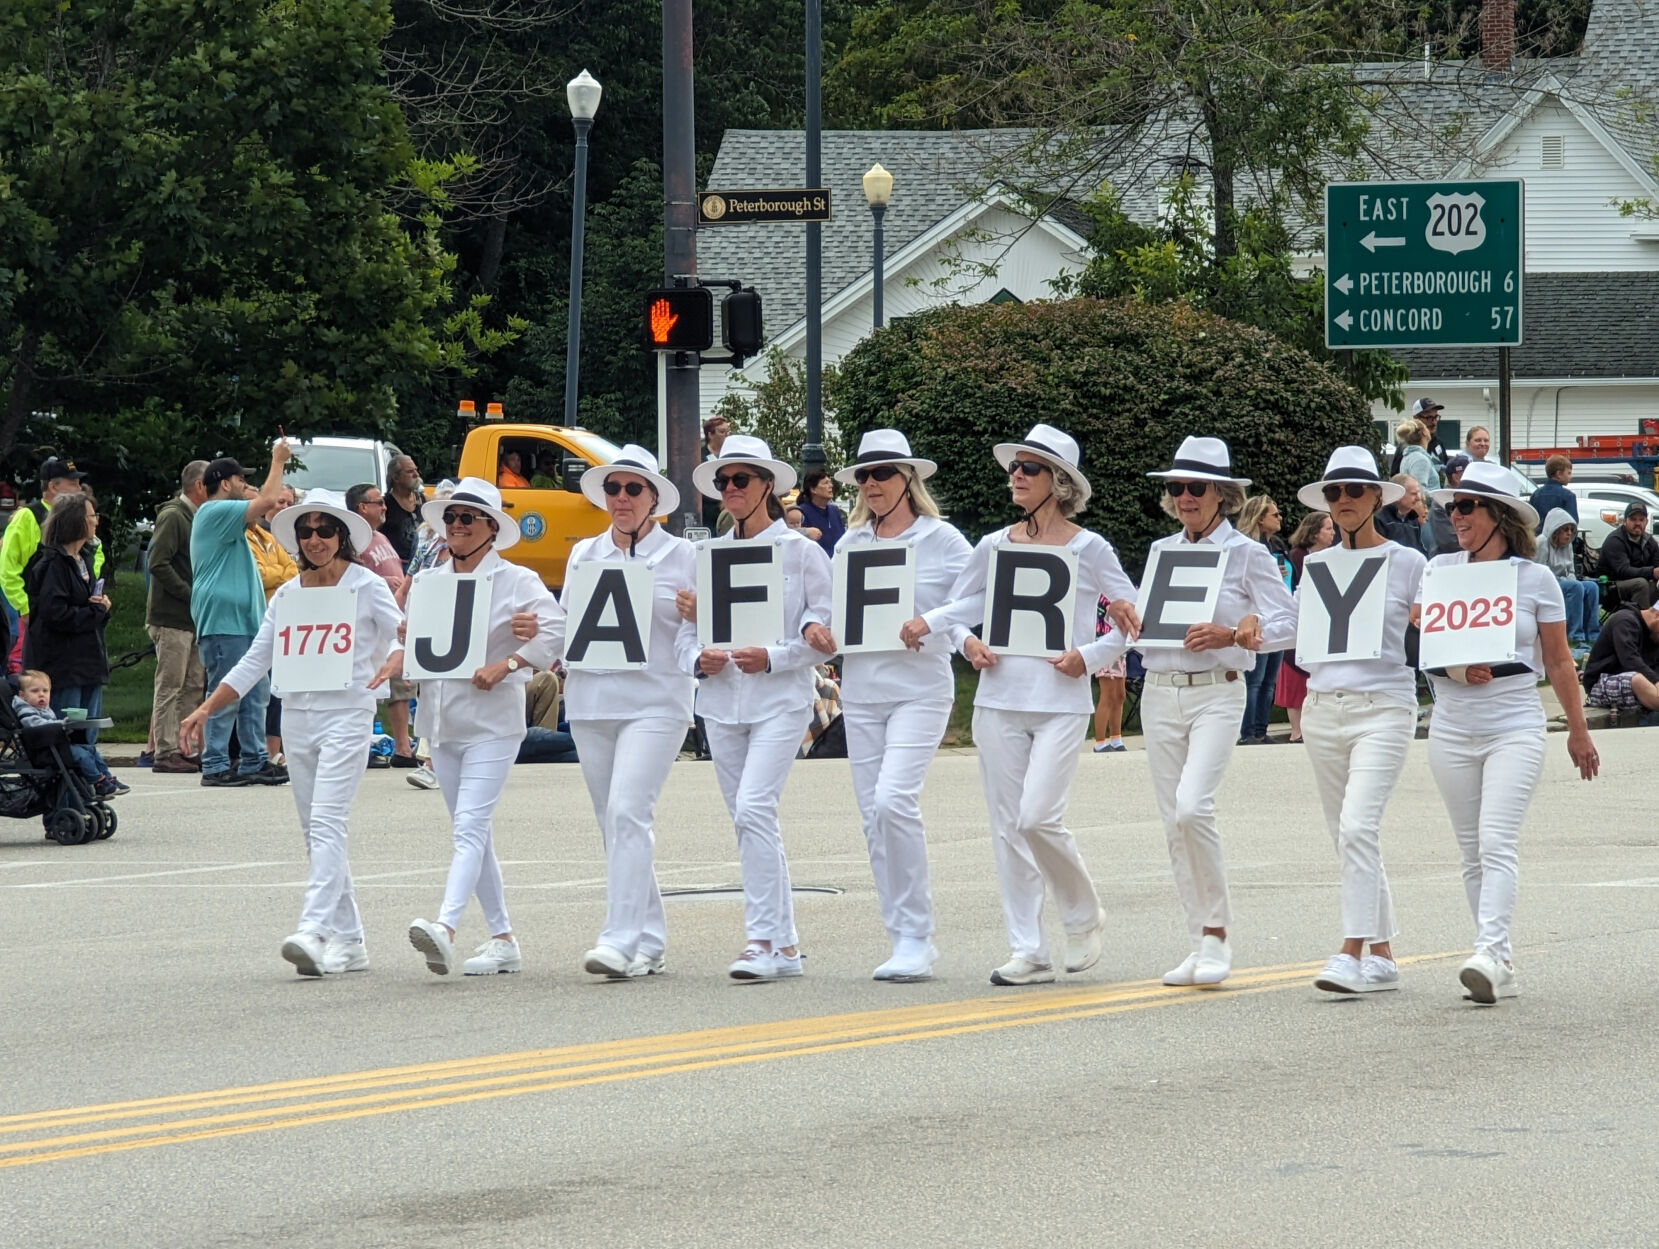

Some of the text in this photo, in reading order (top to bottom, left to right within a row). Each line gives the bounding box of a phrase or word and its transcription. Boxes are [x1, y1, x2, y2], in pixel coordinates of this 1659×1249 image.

[729, 197, 812, 216] Peterborough
[813, 196, 826, 211] St
[1359, 195, 1409, 221] EAST
[1431, 202, 1479, 237] 202
[1359, 270, 1514, 296] PETERBOROUGH 6
[1359, 306, 1514, 332] CONCORD 57
[1423, 595, 1514, 634] 2023
[278, 622, 352, 656] 1773
